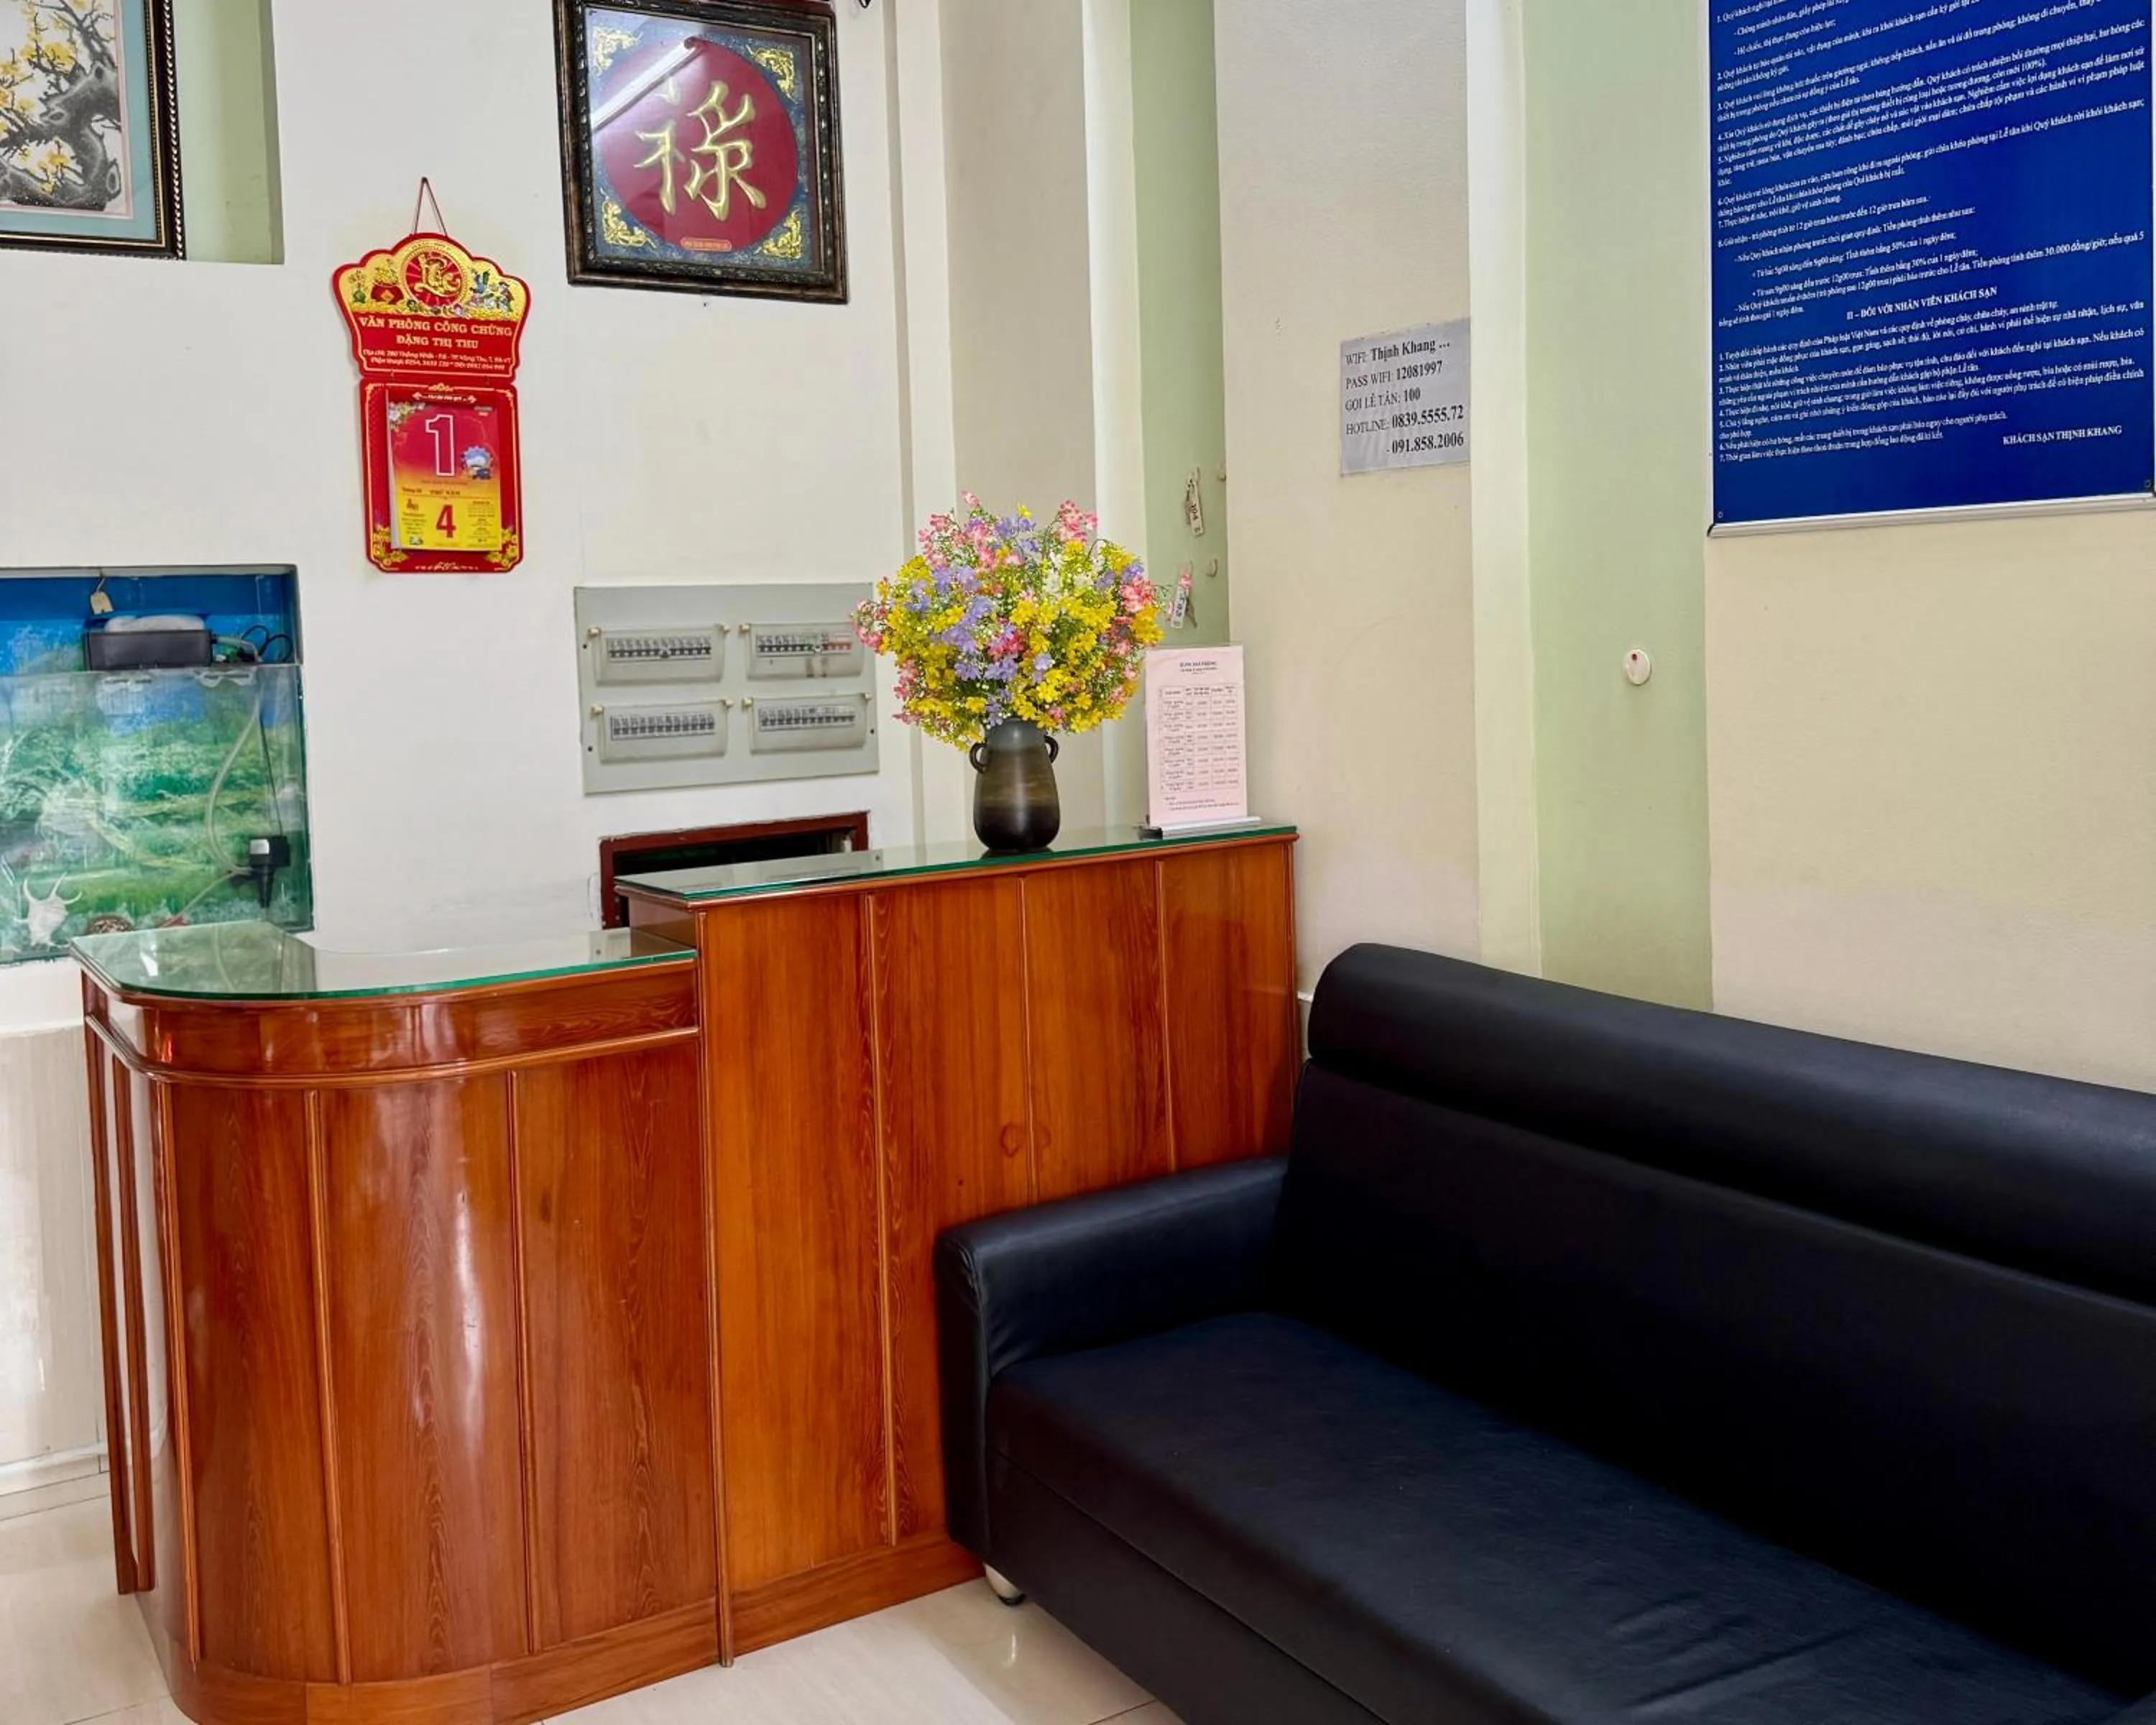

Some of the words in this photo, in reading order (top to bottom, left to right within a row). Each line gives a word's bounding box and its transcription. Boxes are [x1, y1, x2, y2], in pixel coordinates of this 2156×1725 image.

[1894, 298, 1919, 311] NHÂN
[1920, 294, 1942, 306] VIÊN
[1943, 289, 1976, 303] KHÁCH
[1978, 286, 1996, 298] SẠN
[360, 315, 384, 328] VĂN
[389, 318, 430, 331] PHÒNG
[434, 321, 467, 334] CÔNG
[471, 323, 512, 336] CHỨNG
[396, 334, 429, 346] ĐẶNG
[432, 338, 452, 349] THỊ
[456, 339, 479, 349] THU
[1345, 351, 1368, 365] WIFI:
[1370, 344, 1399, 362] Thịnh
[1402, 340, 1435, 356] Khang
[1346, 374, 1368, 390] PASS
[1370, 371, 1393, 385] WIFI:
[1396, 360, 1443, 380] 12081997
[1404, 387, 1421, 402] 100
[1392, 405, 1464, 428] 0839.5555.72
[425, 414, 455, 477] 1
[1392, 431, 1464, 454] 091.858.2006
[2002, 433, 2035, 445] KHÁCH
[2036, 431, 2055, 443] SẠN
[2055, 428, 2085, 441] THỊNH
[2086, 425, 2122, 437] KHANG
[436, 505, 456, 538] 4
